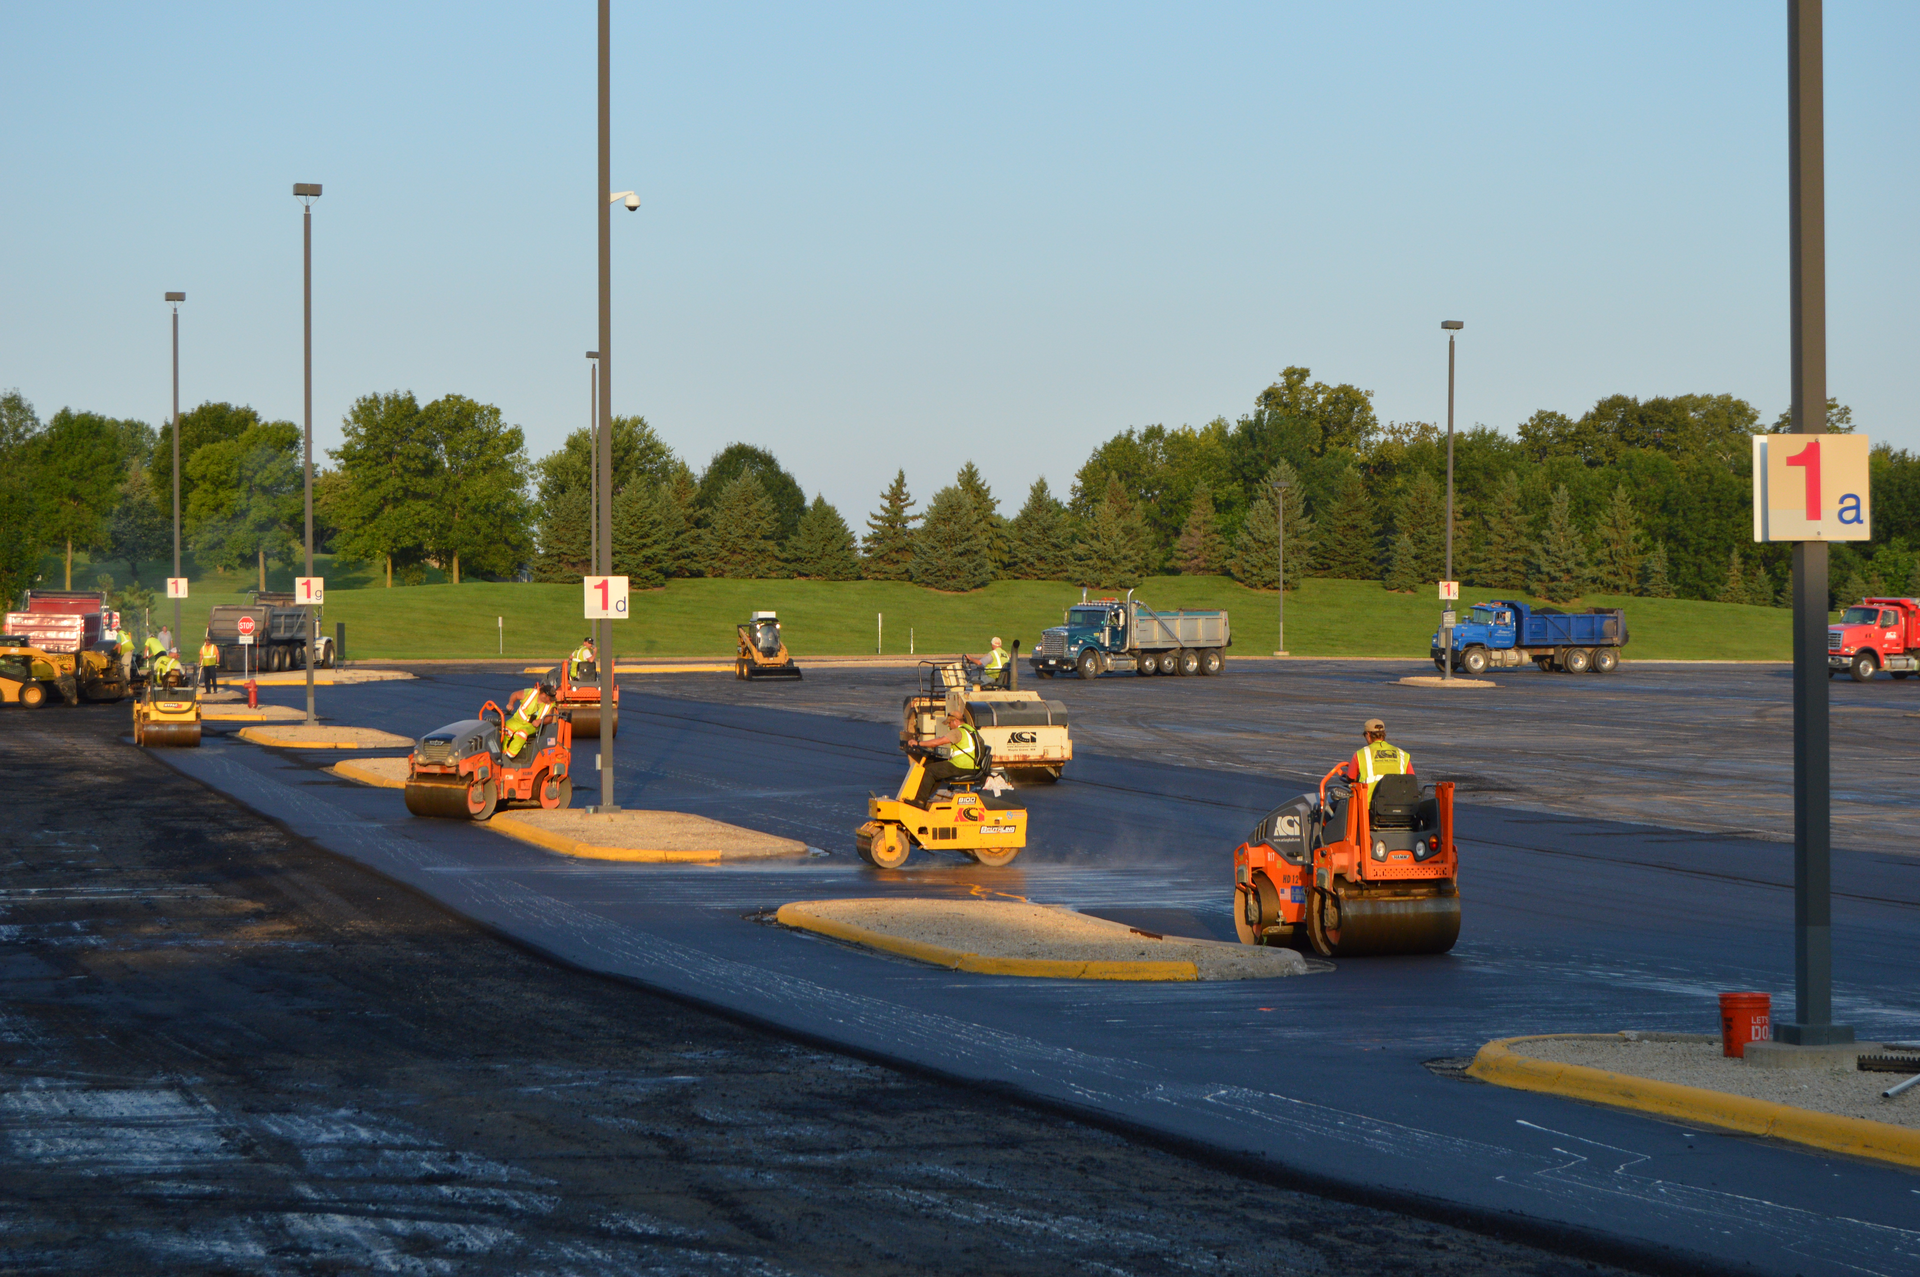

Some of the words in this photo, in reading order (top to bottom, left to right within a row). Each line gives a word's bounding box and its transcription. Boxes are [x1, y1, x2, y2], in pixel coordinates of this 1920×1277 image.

[1786, 442, 1821, 520] 1
[1837, 493, 1864, 525] a
[171, 579, 179, 594] 1
[301, 579, 311, 599] 1
[314, 589, 322, 601] g
[1444, 583, 1451, 596] 1
[594, 579, 608, 610] 1
[615, 596, 626, 612] d
[239, 621, 254, 630] STOP
[1282, 874, 1291, 884] HD
[1292, 875, 1299, 884] 12
[1751, 1025, 1769, 1040] DO
